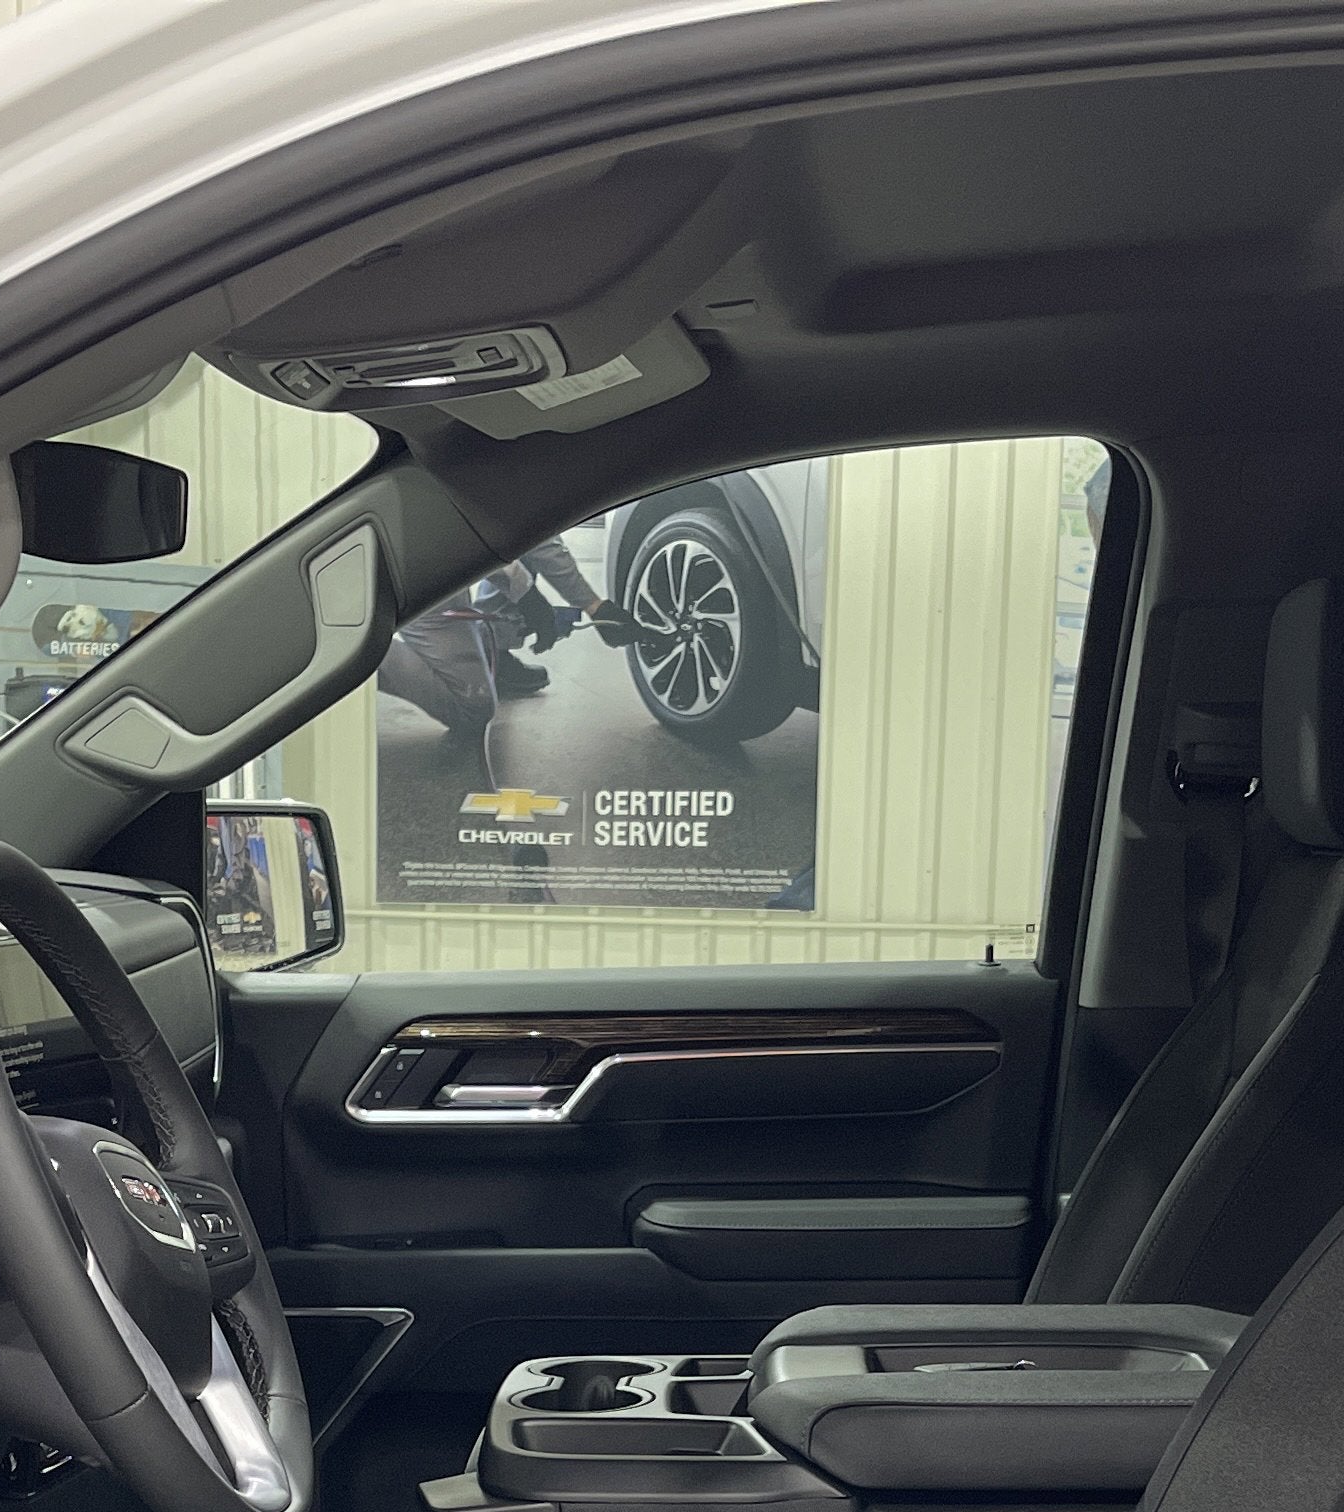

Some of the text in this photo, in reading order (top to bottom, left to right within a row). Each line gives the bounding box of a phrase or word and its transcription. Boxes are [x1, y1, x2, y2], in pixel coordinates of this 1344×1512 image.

[594, 790, 735, 817] CERTIFIED
[458, 829, 574, 846] CHEVROLET
[593, 820, 709, 847] SERVICE
